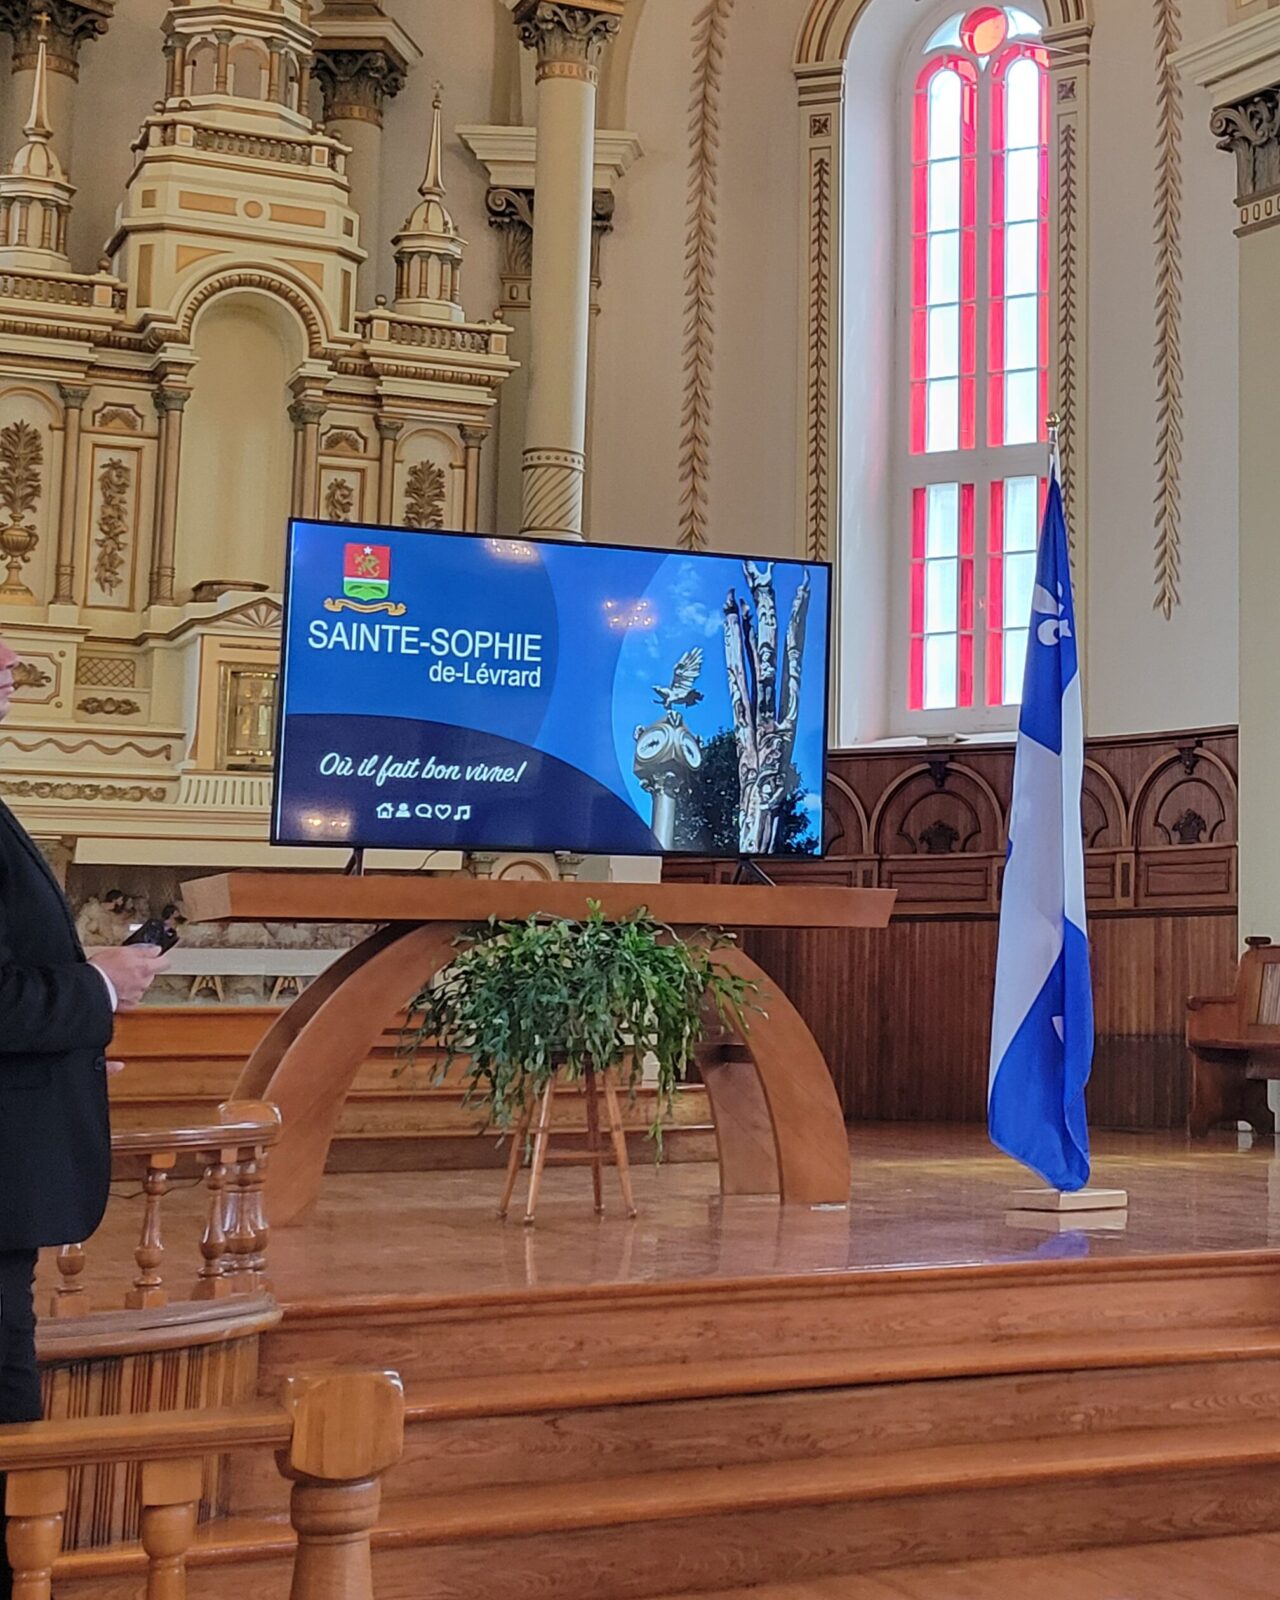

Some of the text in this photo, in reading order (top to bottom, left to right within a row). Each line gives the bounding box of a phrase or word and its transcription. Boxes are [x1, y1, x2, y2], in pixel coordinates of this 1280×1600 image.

[308, 620, 543, 662] SAINTE-SOPHIE
[429, 660, 542, 688] de-Lévrard
[319, 752, 528, 787] Où il fait bon vivre!
